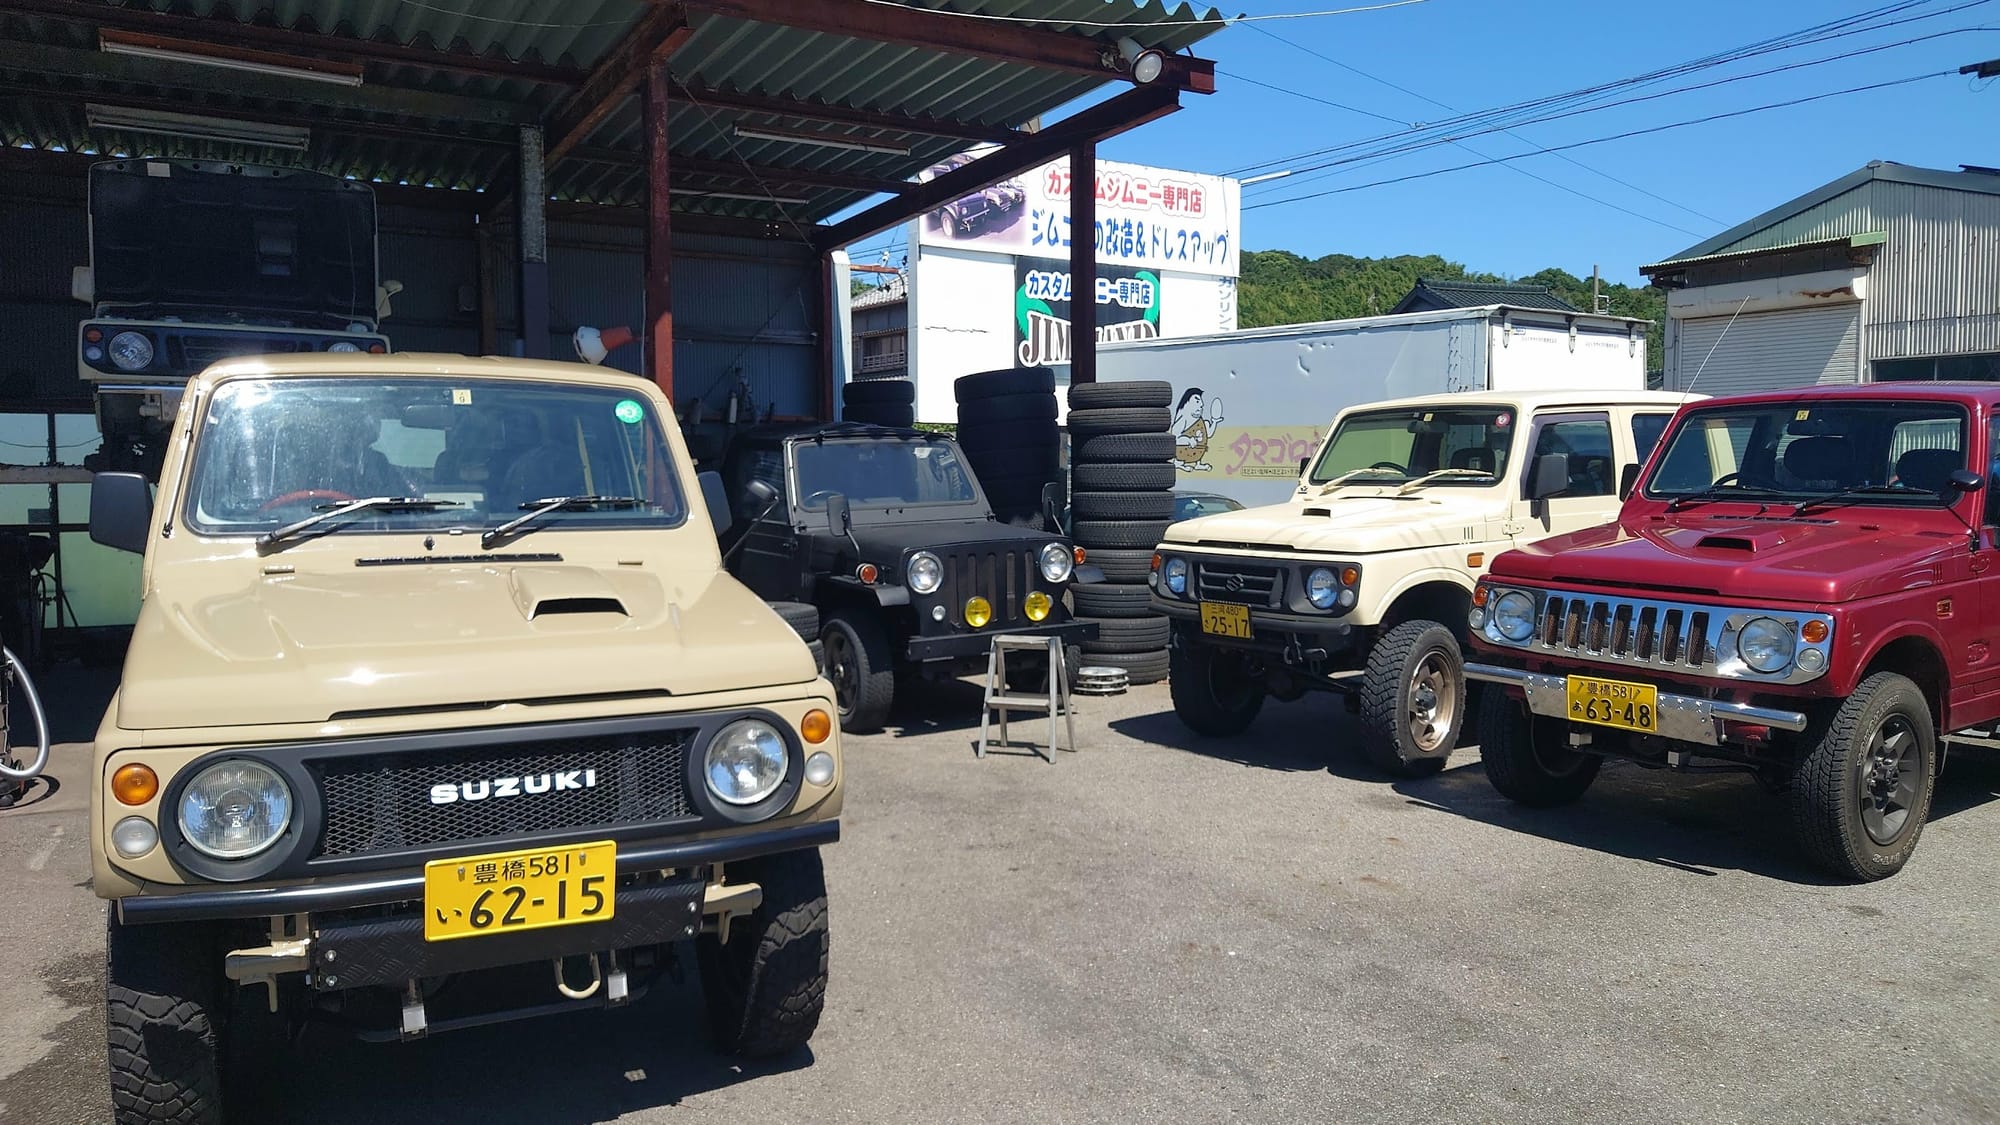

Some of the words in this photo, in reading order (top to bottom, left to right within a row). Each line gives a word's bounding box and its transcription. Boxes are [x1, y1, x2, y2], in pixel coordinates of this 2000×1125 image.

[1211, 616, 1248, 637] 25-17
[1586, 697, 1651, 728] 63-48
[430, 769, 596, 805] SUZUKI
[436, 907, 462, 924] い
[469, 876, 605, 929] 62-15
